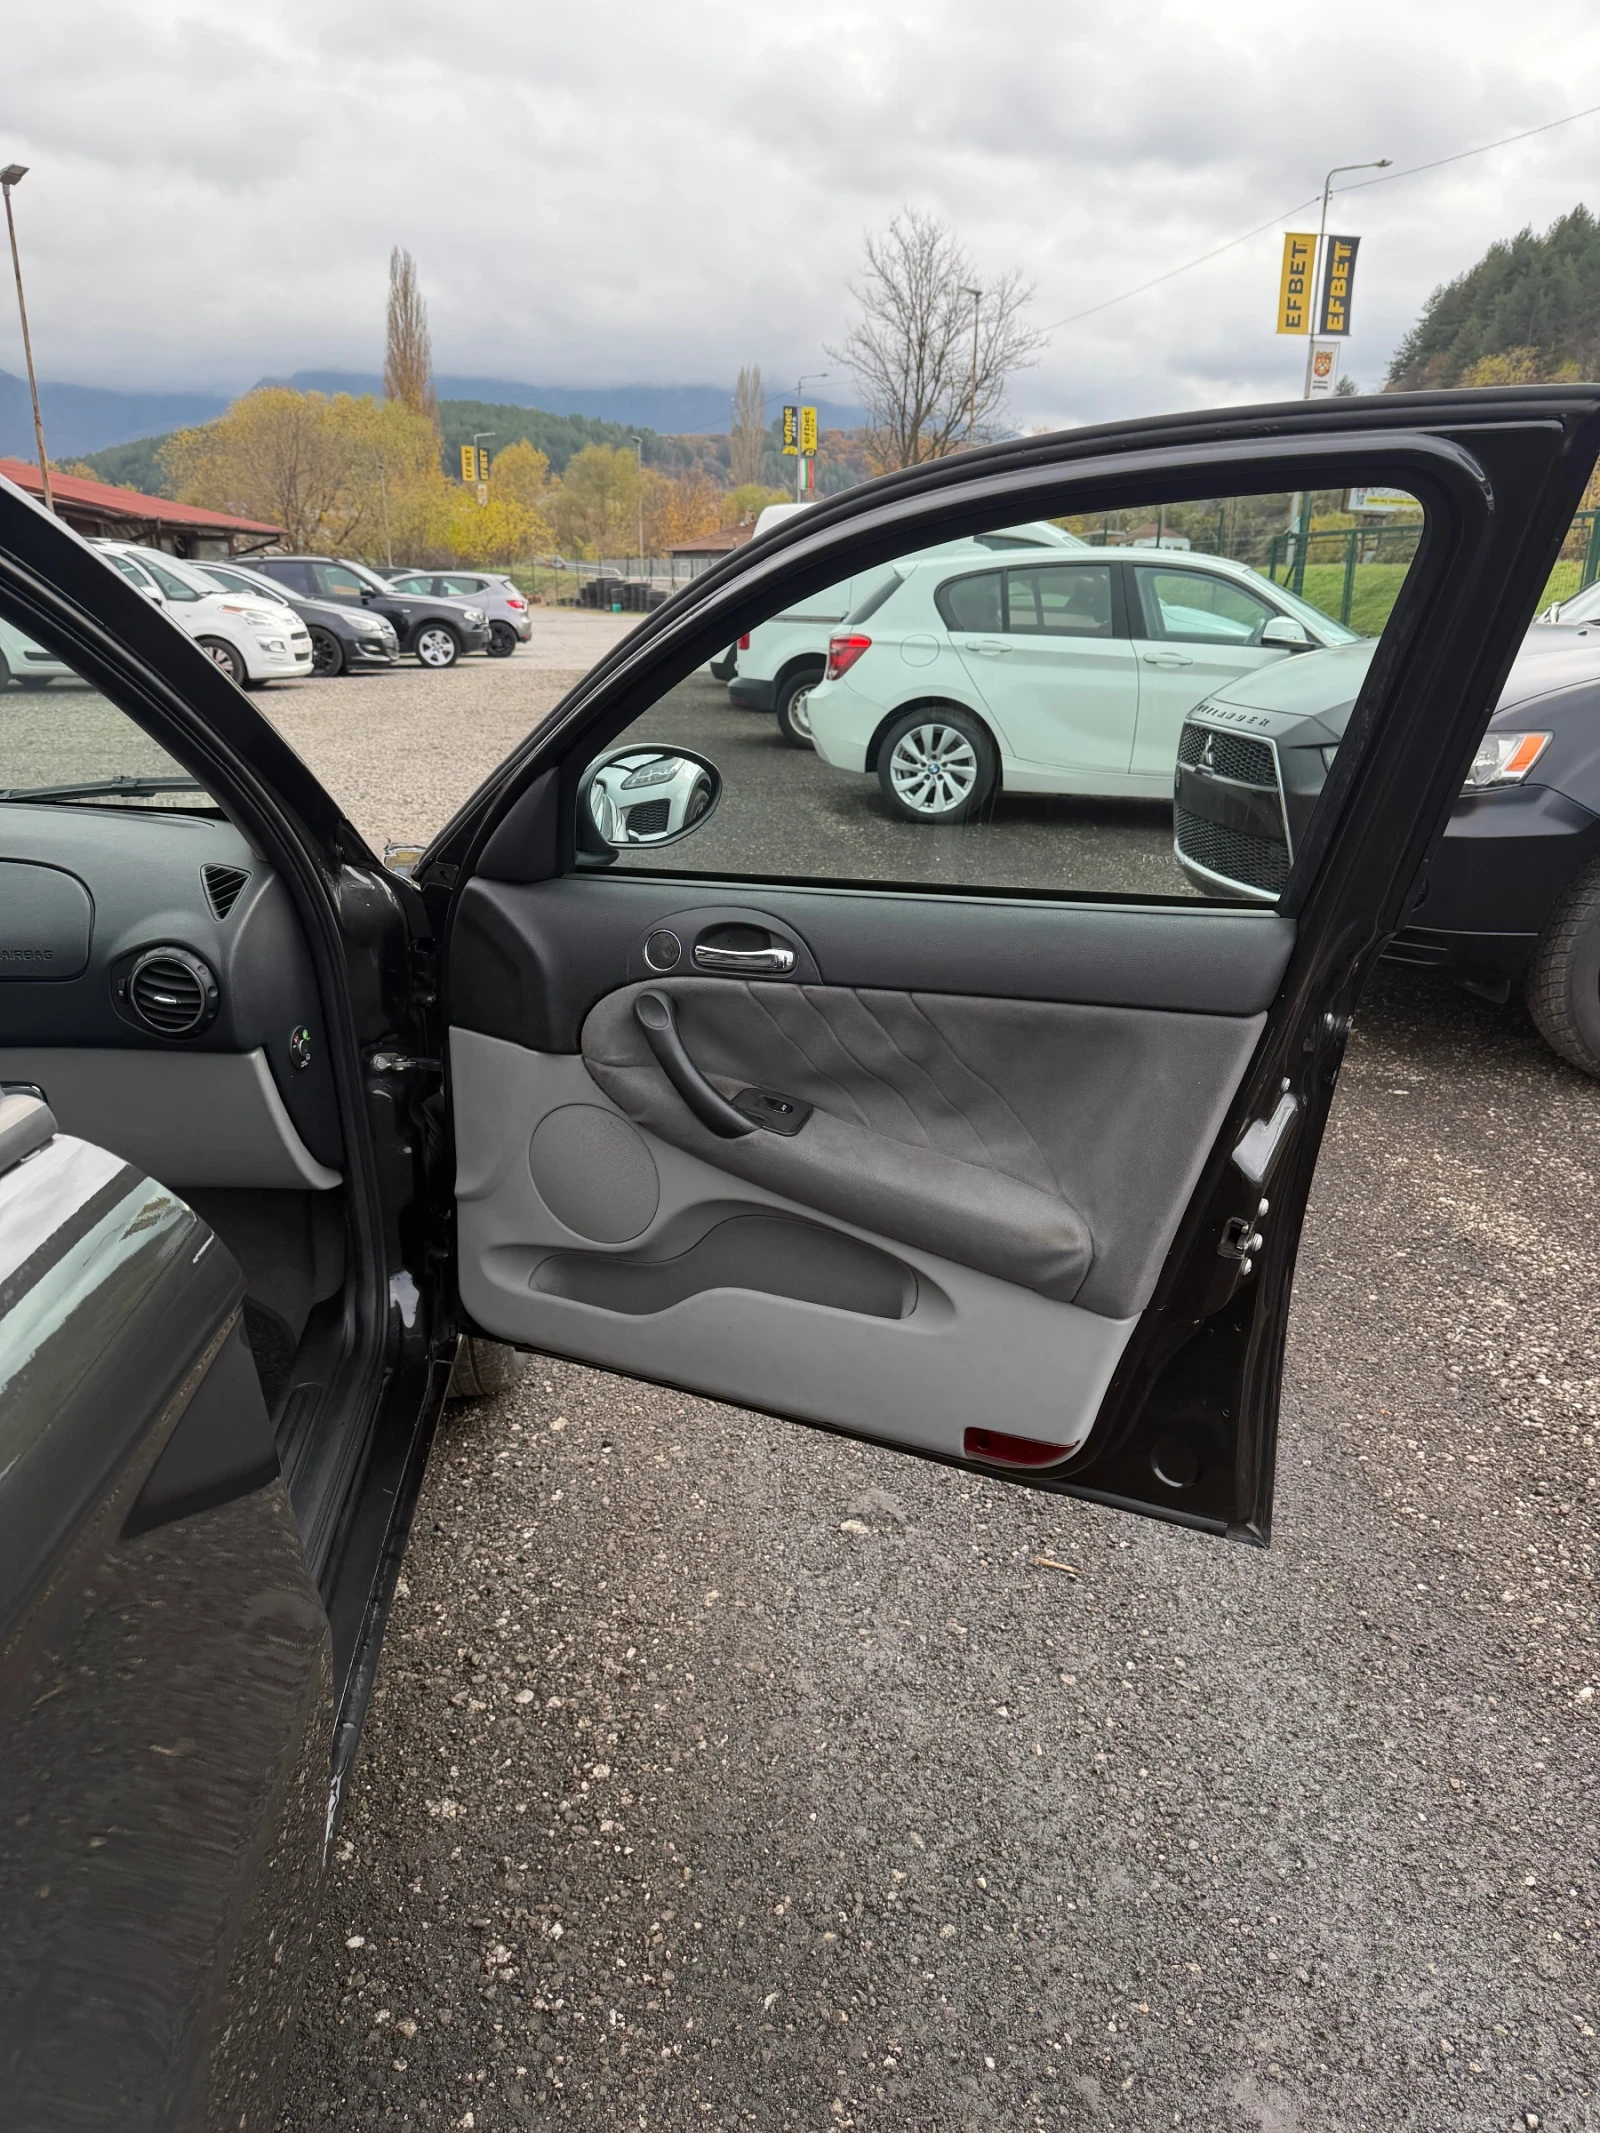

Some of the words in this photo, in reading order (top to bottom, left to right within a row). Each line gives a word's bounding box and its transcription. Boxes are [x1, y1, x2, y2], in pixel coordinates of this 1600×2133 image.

[1285, 240, 1308, 328] EFBET
[1326, 240, 1352, 331] EFBET
[0, 949, 53, 961] AIRBAG
